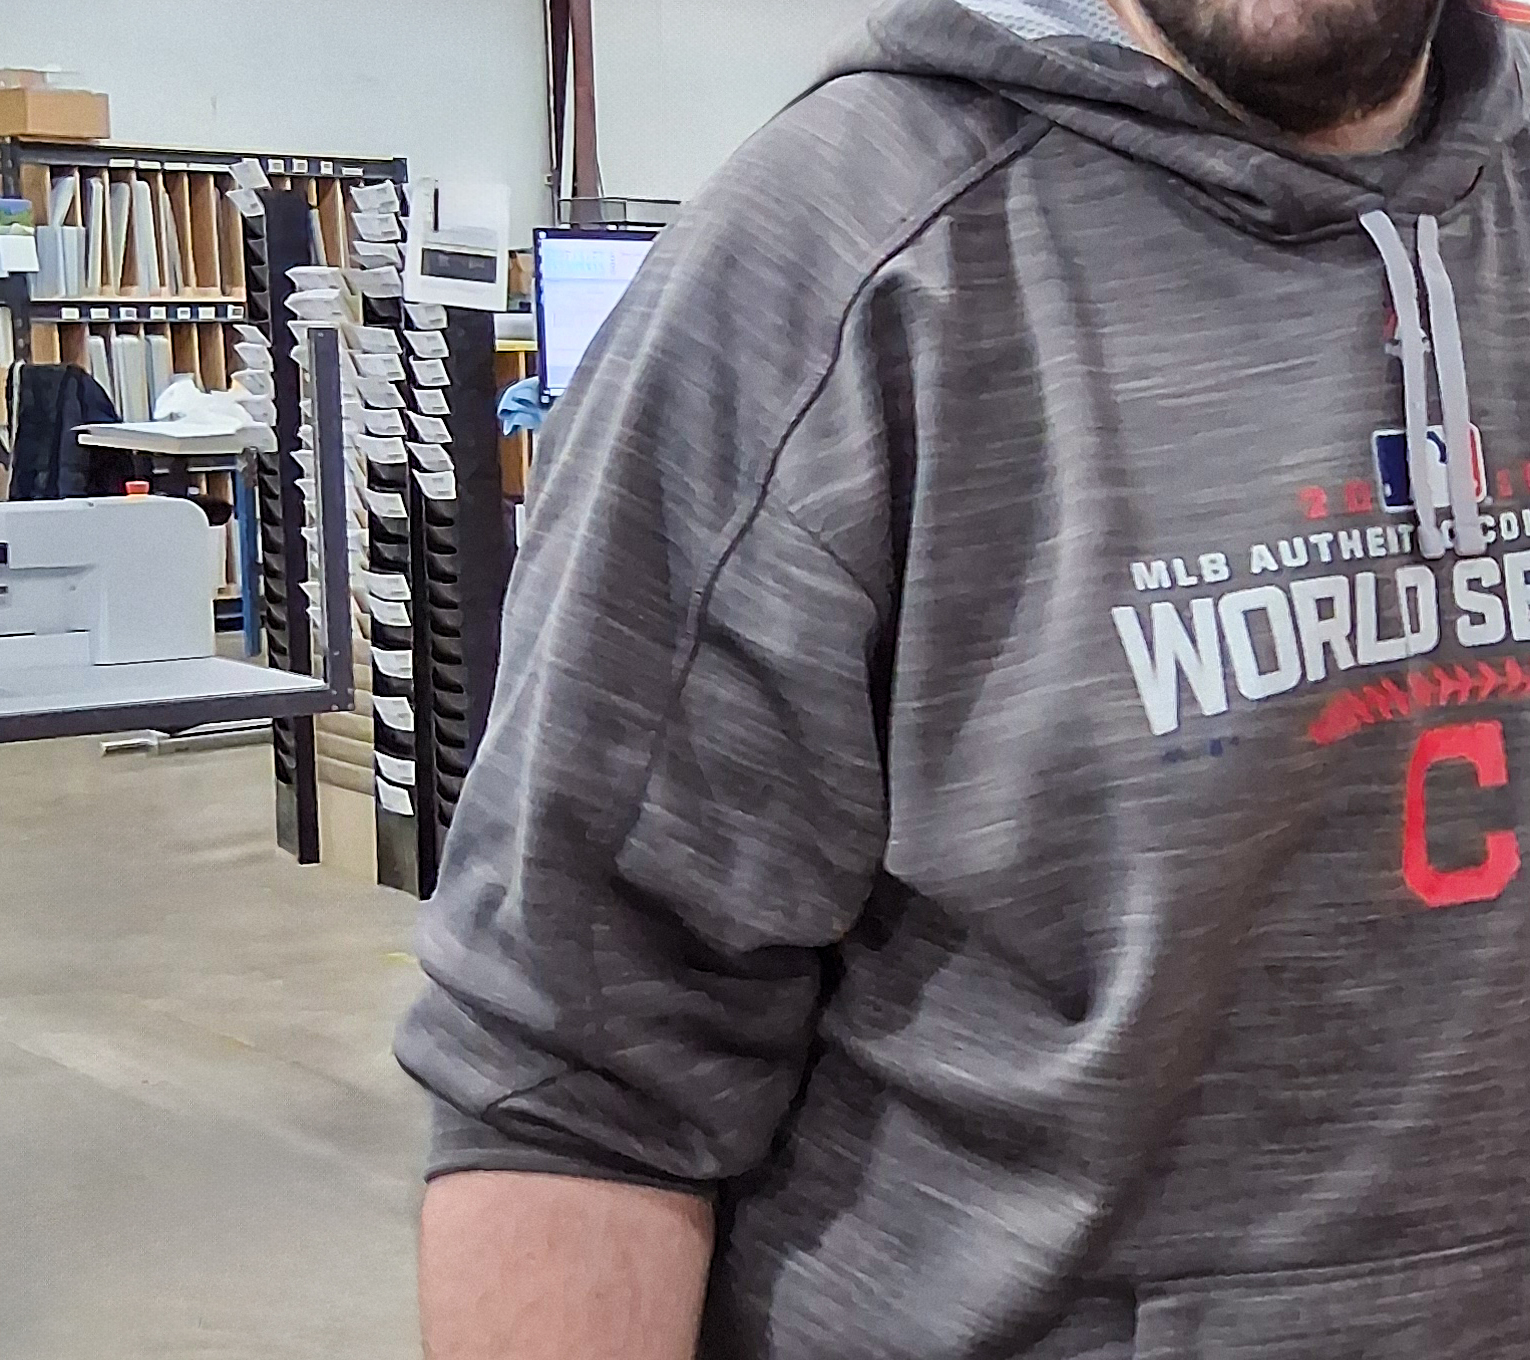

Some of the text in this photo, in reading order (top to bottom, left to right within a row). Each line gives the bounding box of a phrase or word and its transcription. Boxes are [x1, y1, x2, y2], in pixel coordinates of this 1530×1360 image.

[1111, 565, 1442, 736] WORLD
[1130, 552, 1231, 591] MLB
[1403, 719, 1522, 909] C
